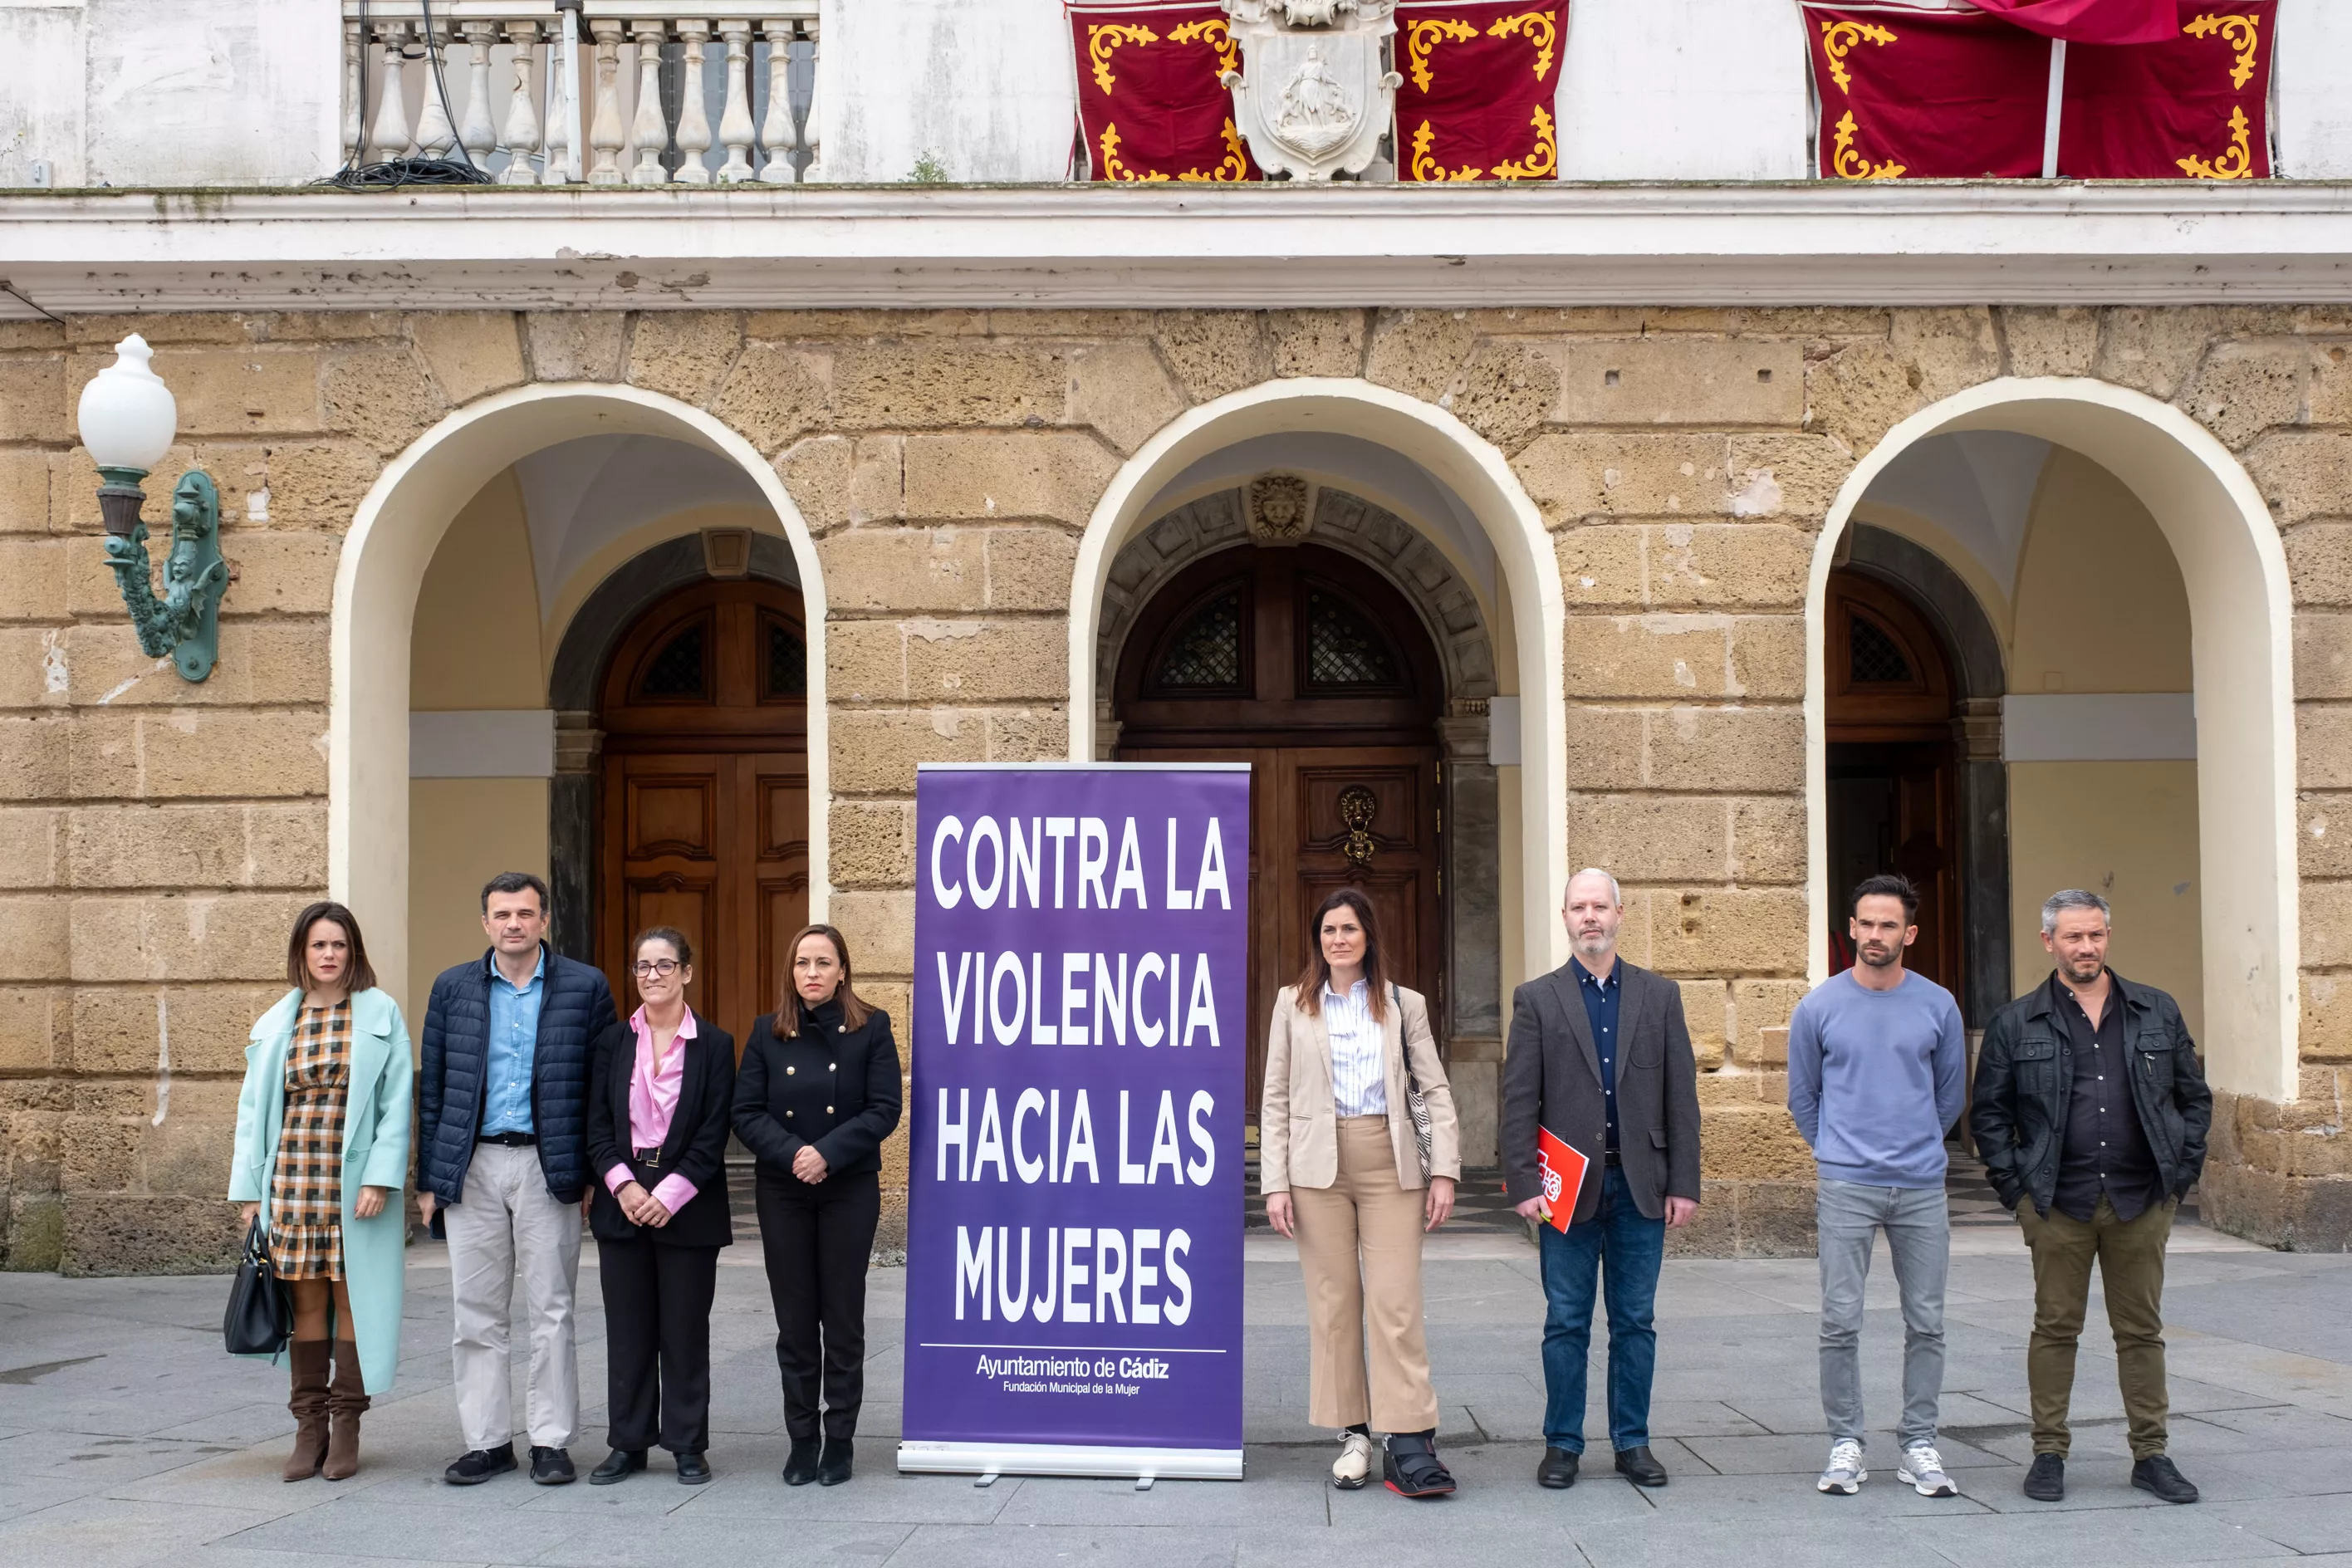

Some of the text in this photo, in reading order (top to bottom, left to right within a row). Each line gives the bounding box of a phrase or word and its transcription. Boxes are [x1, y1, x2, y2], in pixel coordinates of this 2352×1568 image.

[932, 816, 1231, 909] CONTRA LA
[937, 951, 1220, 1047] VIOLENCIA
[938, 1088, 1215, 1186] HACIA LAS
[956, 1226, 1192, 1325] MUJERES
[977, 1355, 1169, 1379] Ayuntamiento de Cádiz
[1004, 1381, 1046, 1392] Fundación
[1092, 1383, 1103, 1394] de
[1105, 1384, 1113, 1394] la
[1115, 1384, 1139, 1396] Mujer
